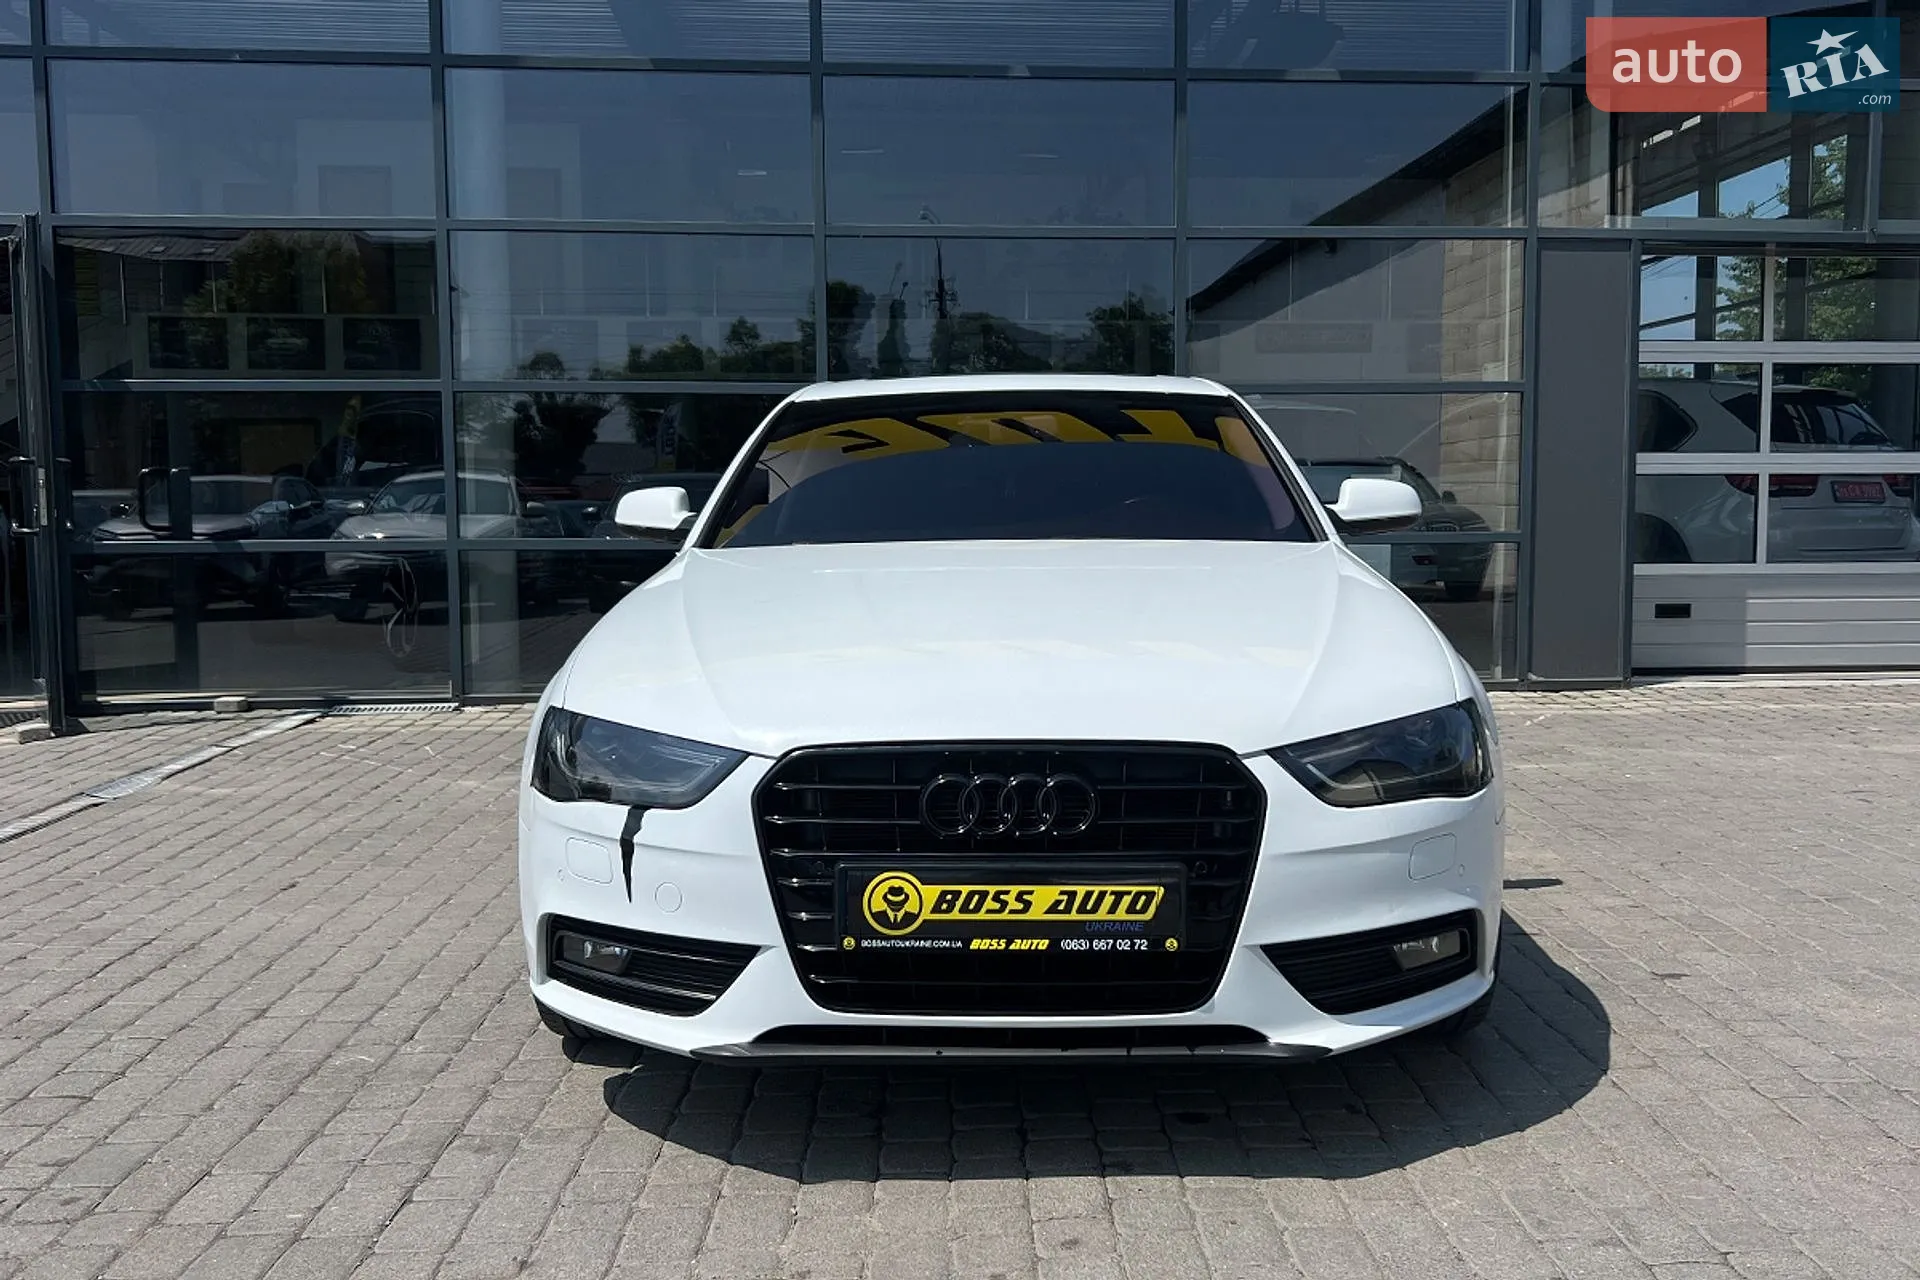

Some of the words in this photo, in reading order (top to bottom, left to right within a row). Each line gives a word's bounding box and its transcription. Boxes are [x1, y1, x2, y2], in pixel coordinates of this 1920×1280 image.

[929, 889, 1036, 915] BOSS
[1043, 889, 1158, 915] AUTO
[1084, 921, 1145, 932] UKRAINE
[969, 938, 1007, 950] BOSS
[1008, 939, 1050, 950] AUTO
[1060, 938, 1090, 951] (063)
[1092, 939, 1113, 950] 667
[1116, 939, 1131, 950] 02
[1133, 939, 1149, 950] 72
